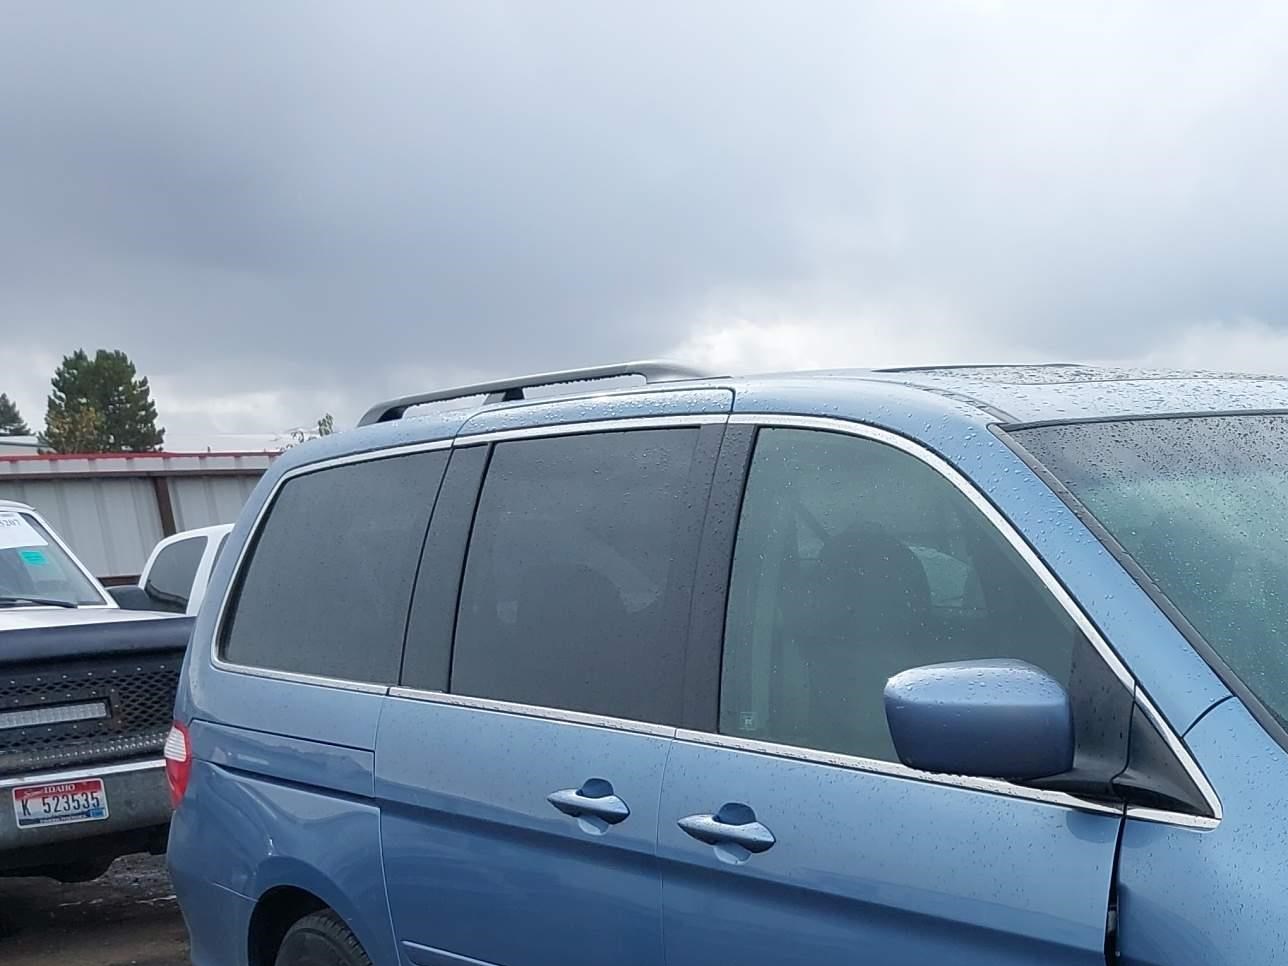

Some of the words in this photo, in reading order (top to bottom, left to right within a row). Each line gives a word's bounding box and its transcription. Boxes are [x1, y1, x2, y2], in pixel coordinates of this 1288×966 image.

[43, 783, 76, 793] IDAHO
[21, 799, 32, 816] K
[41, 791, 100, 814] 523535
